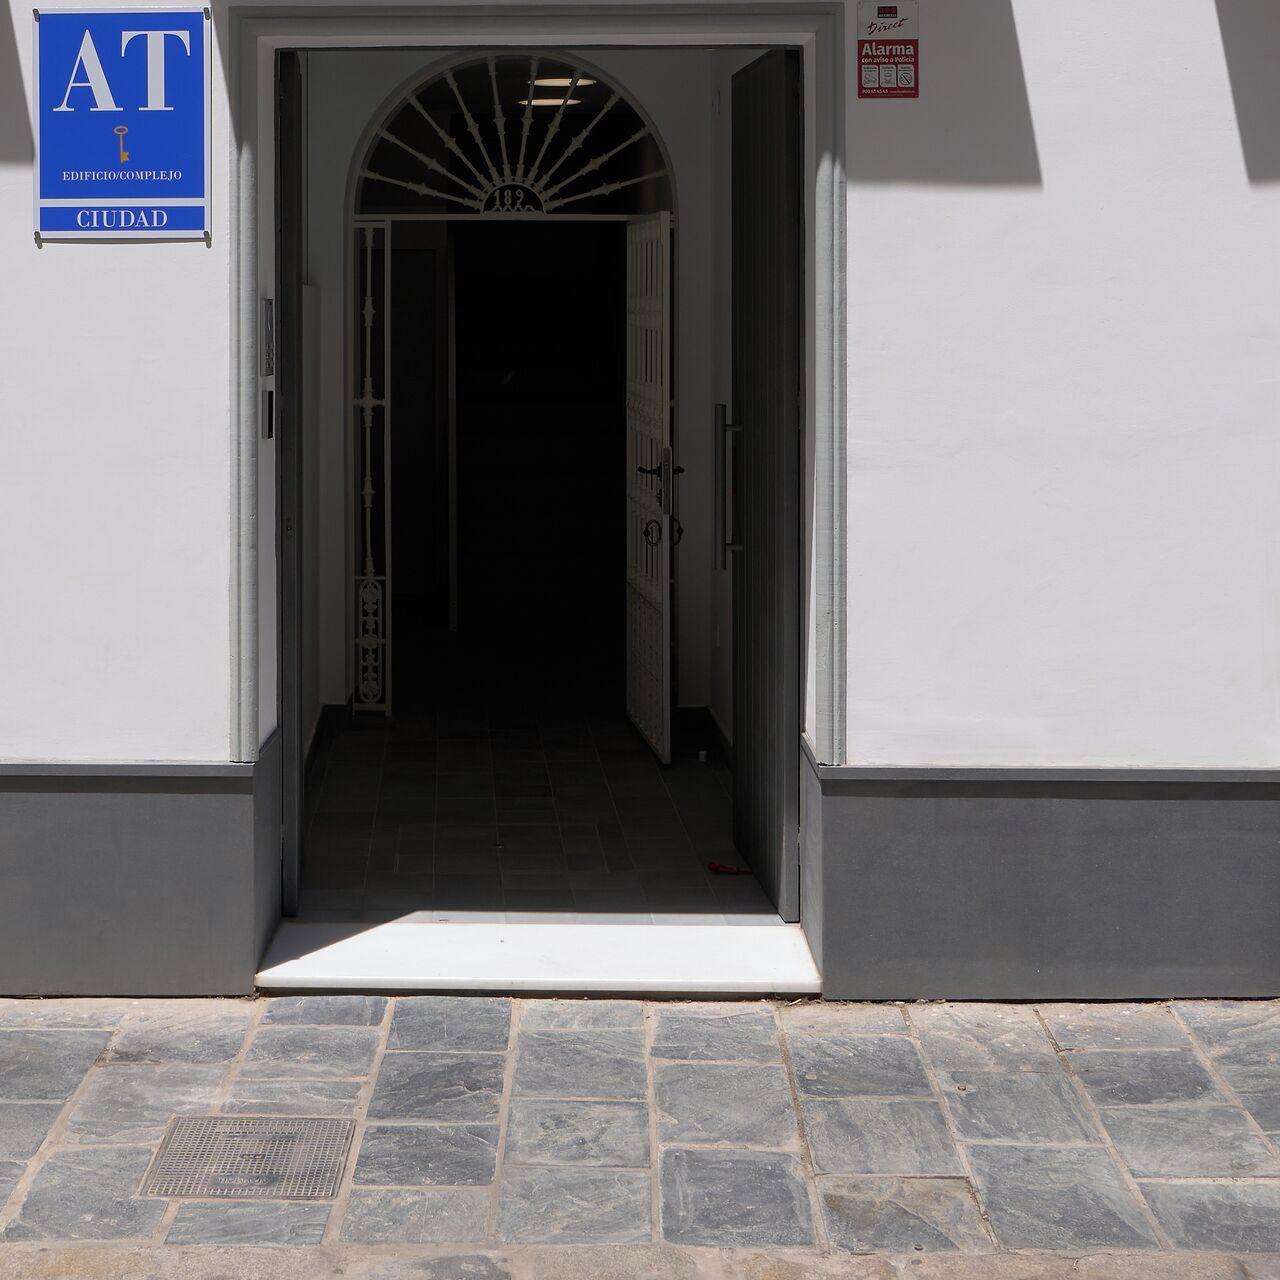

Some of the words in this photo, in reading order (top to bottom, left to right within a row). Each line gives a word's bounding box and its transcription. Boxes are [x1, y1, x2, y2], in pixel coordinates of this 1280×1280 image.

[867, 18, 909, 35] Direct
[862, 42, 914, 55] Alarma
[53, 29, 190, 112] AT
[63, 170, 182, 181] EDIFICIO/COMPLEJO
[77, 209, 168, 228] CIUDAD
